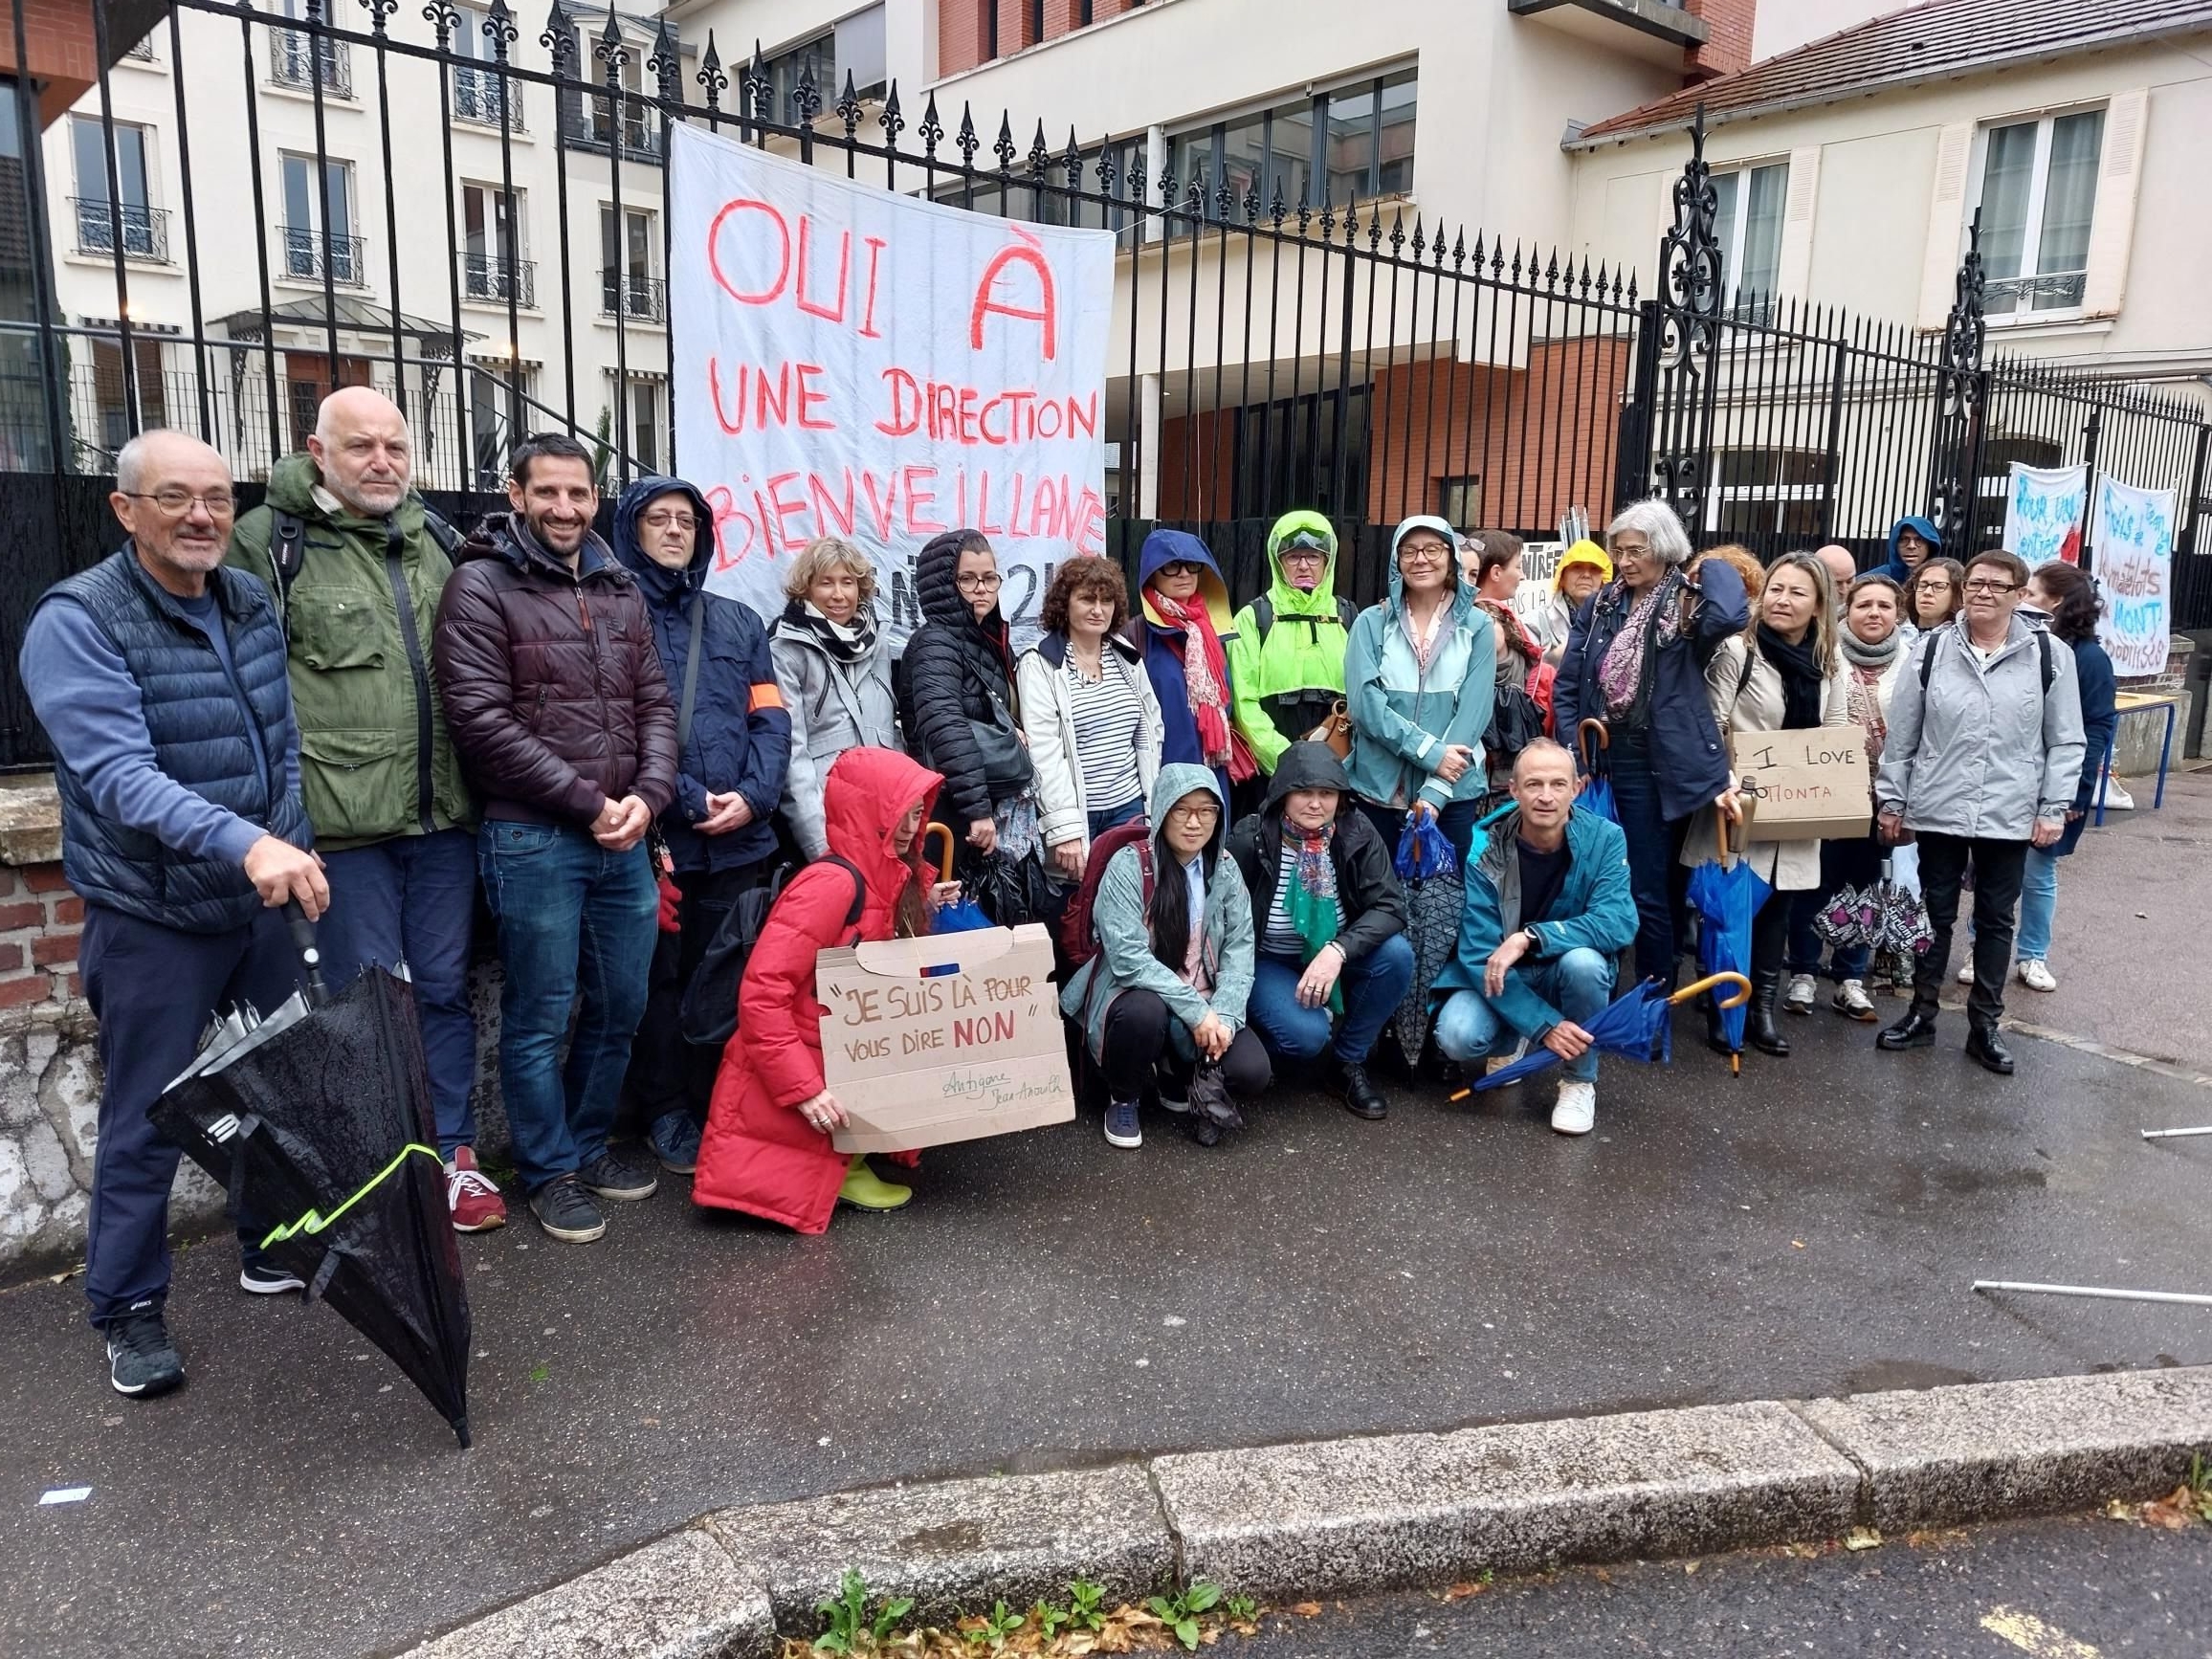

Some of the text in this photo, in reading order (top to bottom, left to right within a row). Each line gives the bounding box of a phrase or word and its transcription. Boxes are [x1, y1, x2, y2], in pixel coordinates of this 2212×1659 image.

[708, 198, 1058, 361] OUI À
[709, 356, 1097, 445] UNE DIRECTION
[1753, 744, 1856, 770] I LOVE
[952, 972, 977, 1009] LÀ
[983, 974, 1033, 1003] POUR
[844, 1036, 891, 1063] VOUS
